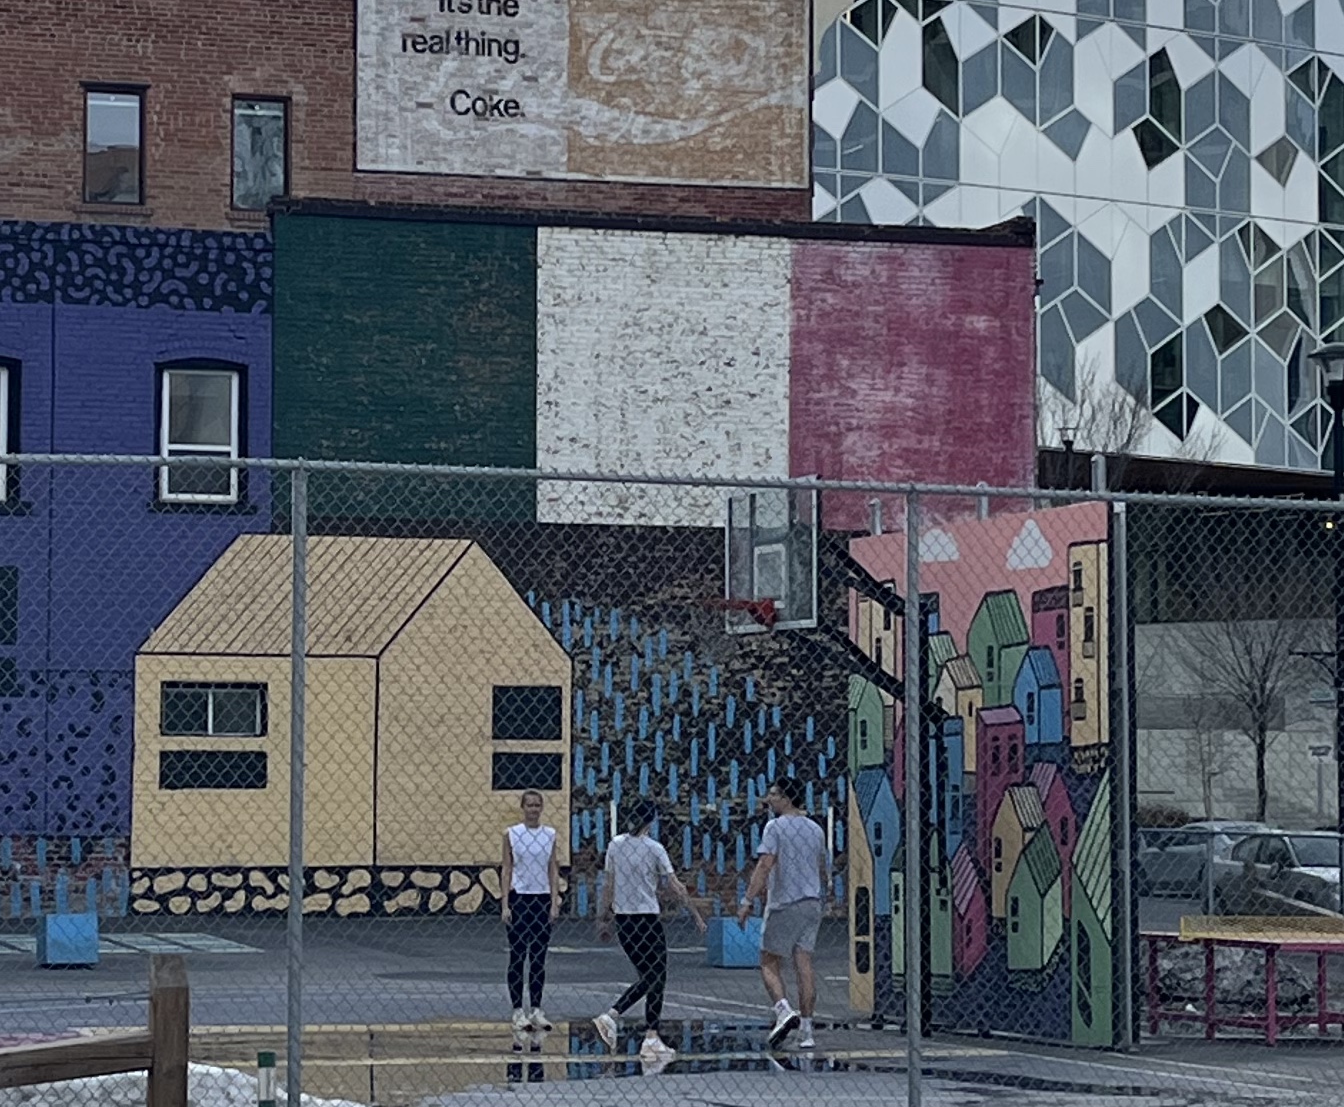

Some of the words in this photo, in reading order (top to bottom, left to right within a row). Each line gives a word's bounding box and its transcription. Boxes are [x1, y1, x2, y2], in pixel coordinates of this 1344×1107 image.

[401, 29, 451, 54] real
[455, 29, 525, 64] thing.
[450, 89, 525, 118] Coke.
